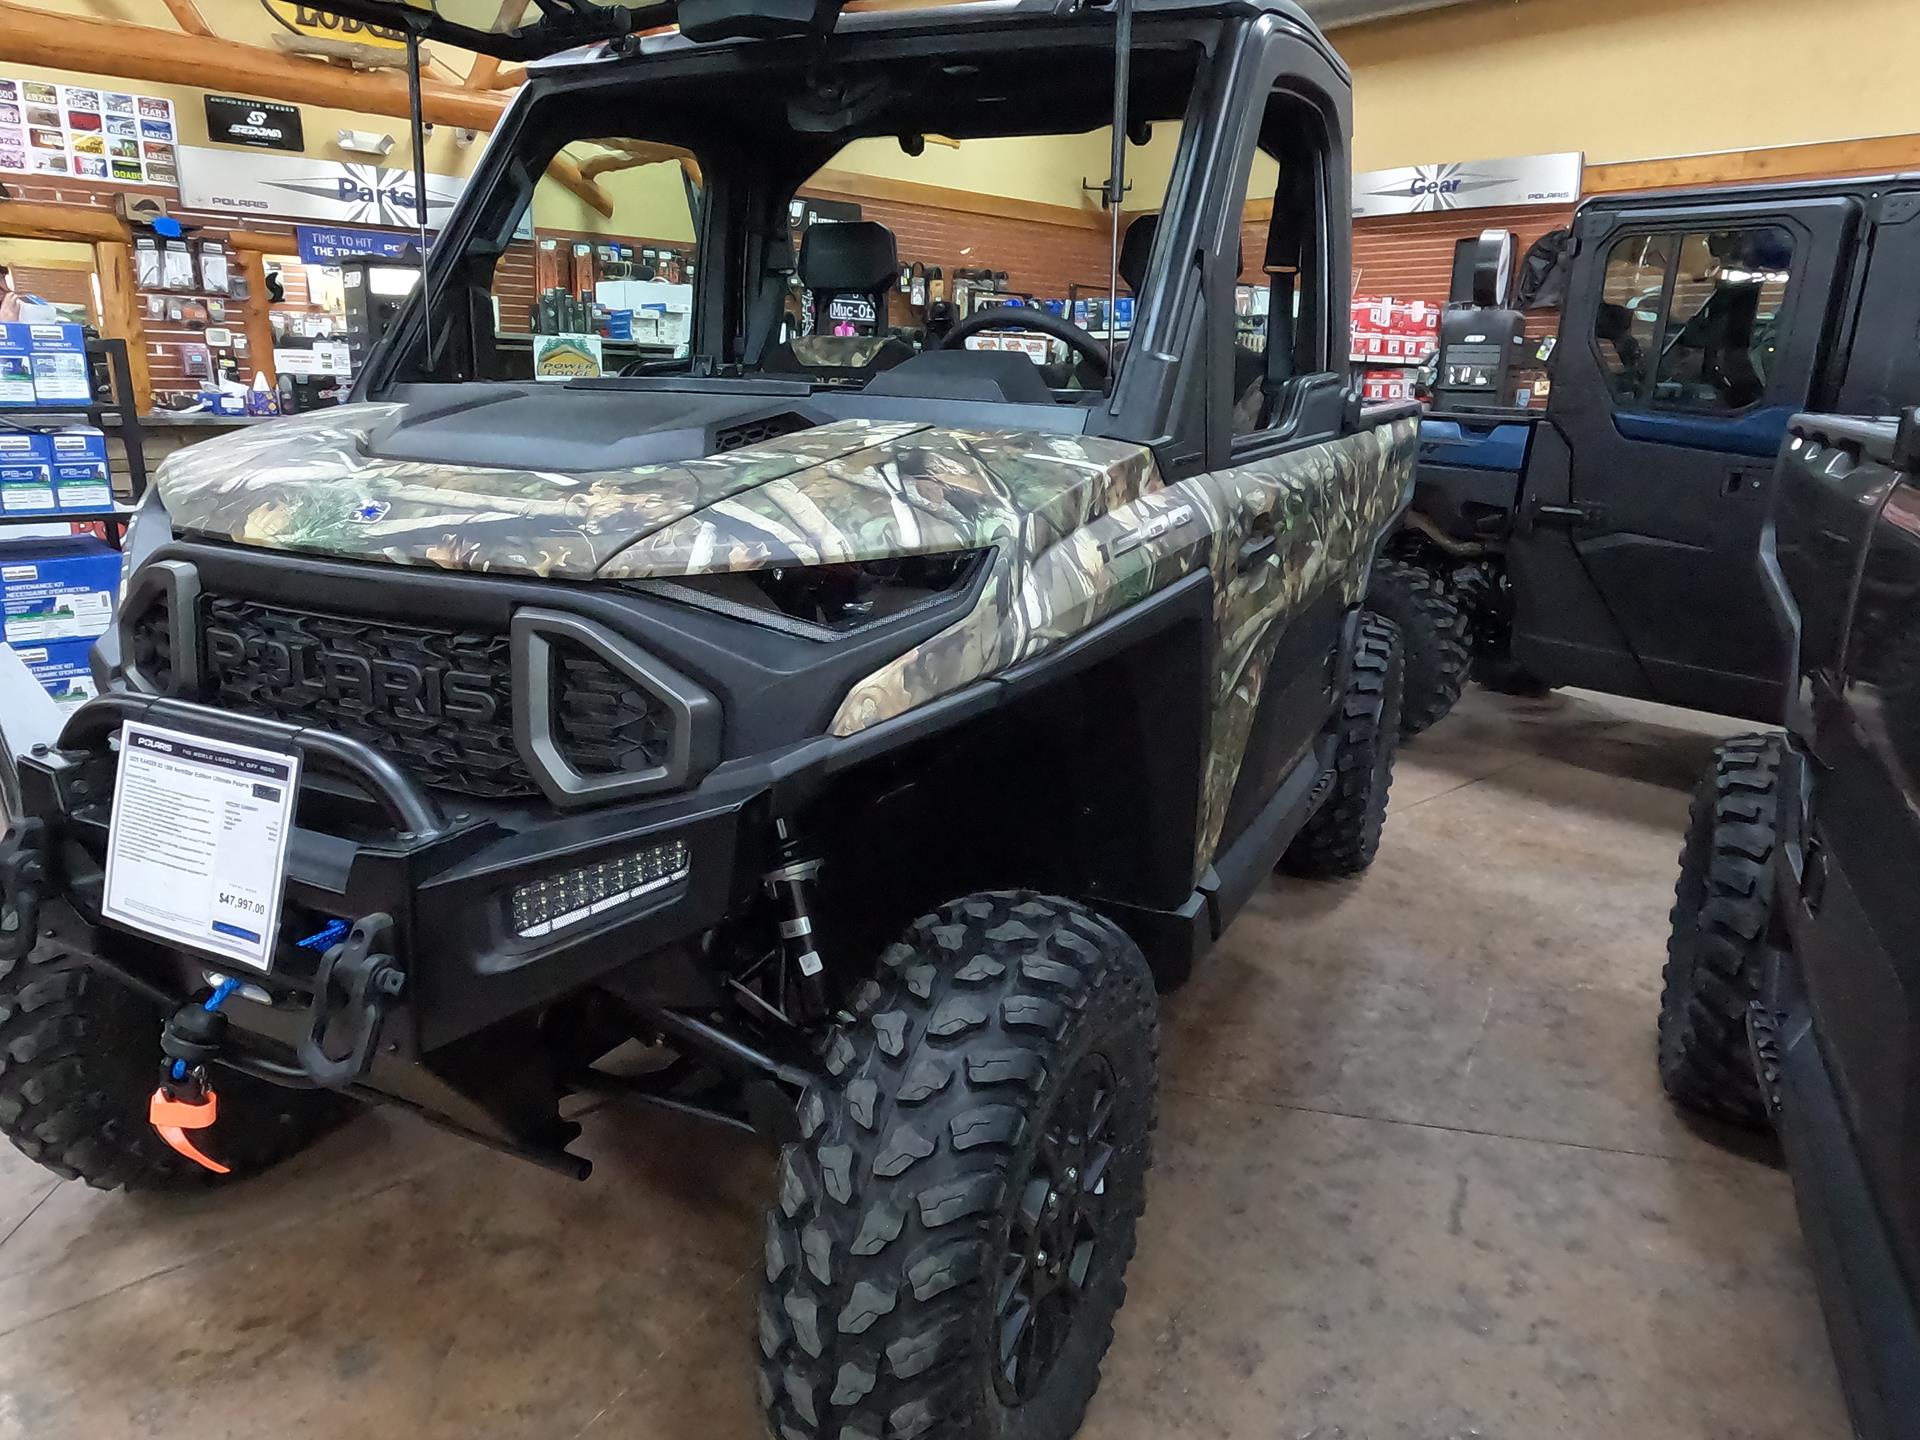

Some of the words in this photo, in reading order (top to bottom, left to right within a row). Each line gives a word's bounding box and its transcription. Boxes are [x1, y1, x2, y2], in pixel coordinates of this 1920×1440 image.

[227, 124, 282, 138] SEDONA
[338, 177, 416, 209] Parts
[1410, 177, 1462, 196] Gear
[1527, 191, 1570, 200] POLARIS
[211, 197, 269, 209] POLARIS
[312, 233, 337, 246] TIME
[340, 235, 353, 247] TO
[355, 237, 373, 249] HIT
[312, 245, 334, 257] THE
[544, 362, 593, 370] POWER
[546, 369, 591, 377] LODGE
[206, 627, 497, 722] POLARIS
[137, 737, 173, 752] POLARIS
[218, 892, 265, 915] $47,997.00
